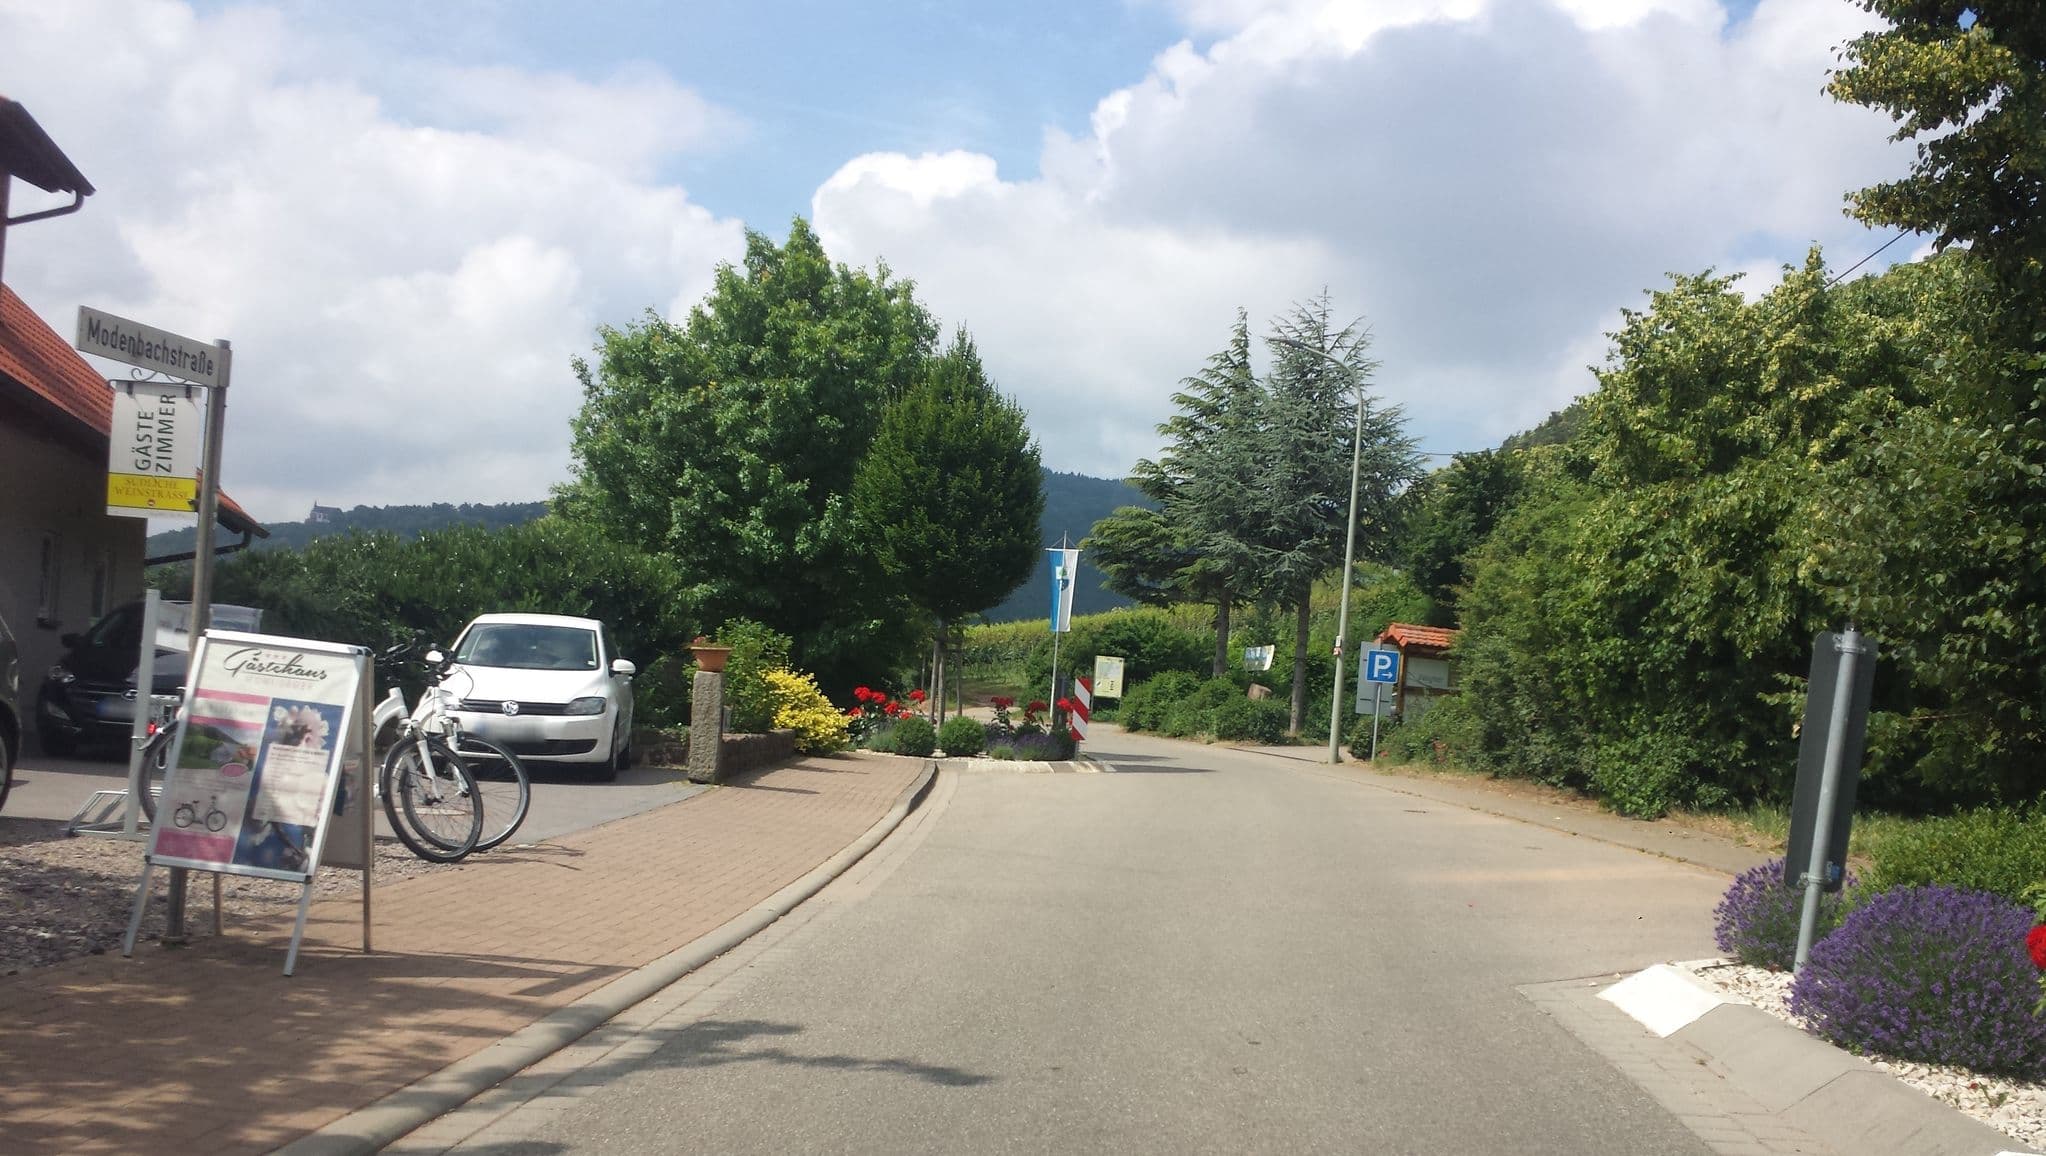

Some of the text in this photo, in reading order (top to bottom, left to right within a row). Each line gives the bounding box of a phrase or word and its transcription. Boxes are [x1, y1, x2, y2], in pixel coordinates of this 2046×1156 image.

[87, 316, 214, 376] Modenbachstraße
[131, 411, 154, 471] GÄSTE
[155, 393, 177, 474] ZIMMER
[224, 648, 328, 680] Gästehaus
[1374, 655, 1392, 678] P
